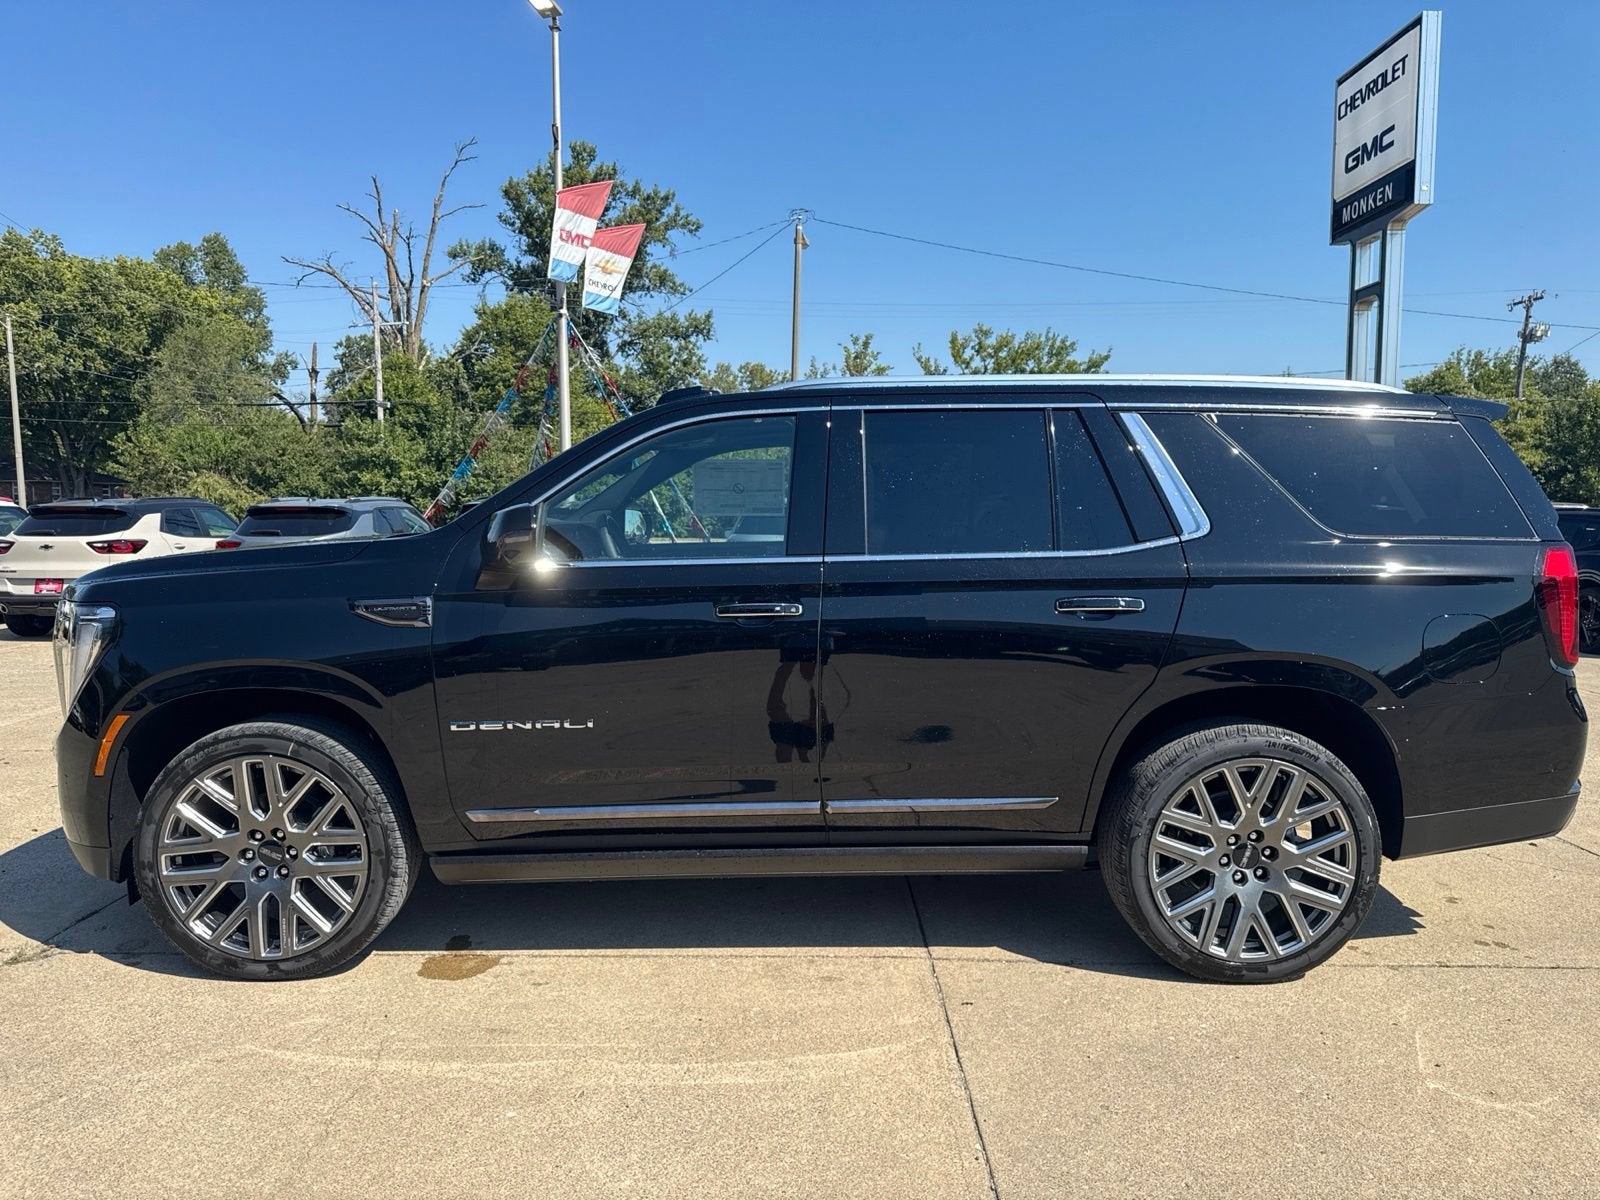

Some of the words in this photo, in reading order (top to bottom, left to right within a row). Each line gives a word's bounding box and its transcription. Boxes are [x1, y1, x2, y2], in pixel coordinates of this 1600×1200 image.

[1338, 54, 1408, 121] CHEVROLET
[1344, 124, 1396, 175] GMC
[1341, 182, 1393, 225] MONKEN
[588, 278, 615, 292] CHEVRO
[449, 718, 594, 732] DENALI
